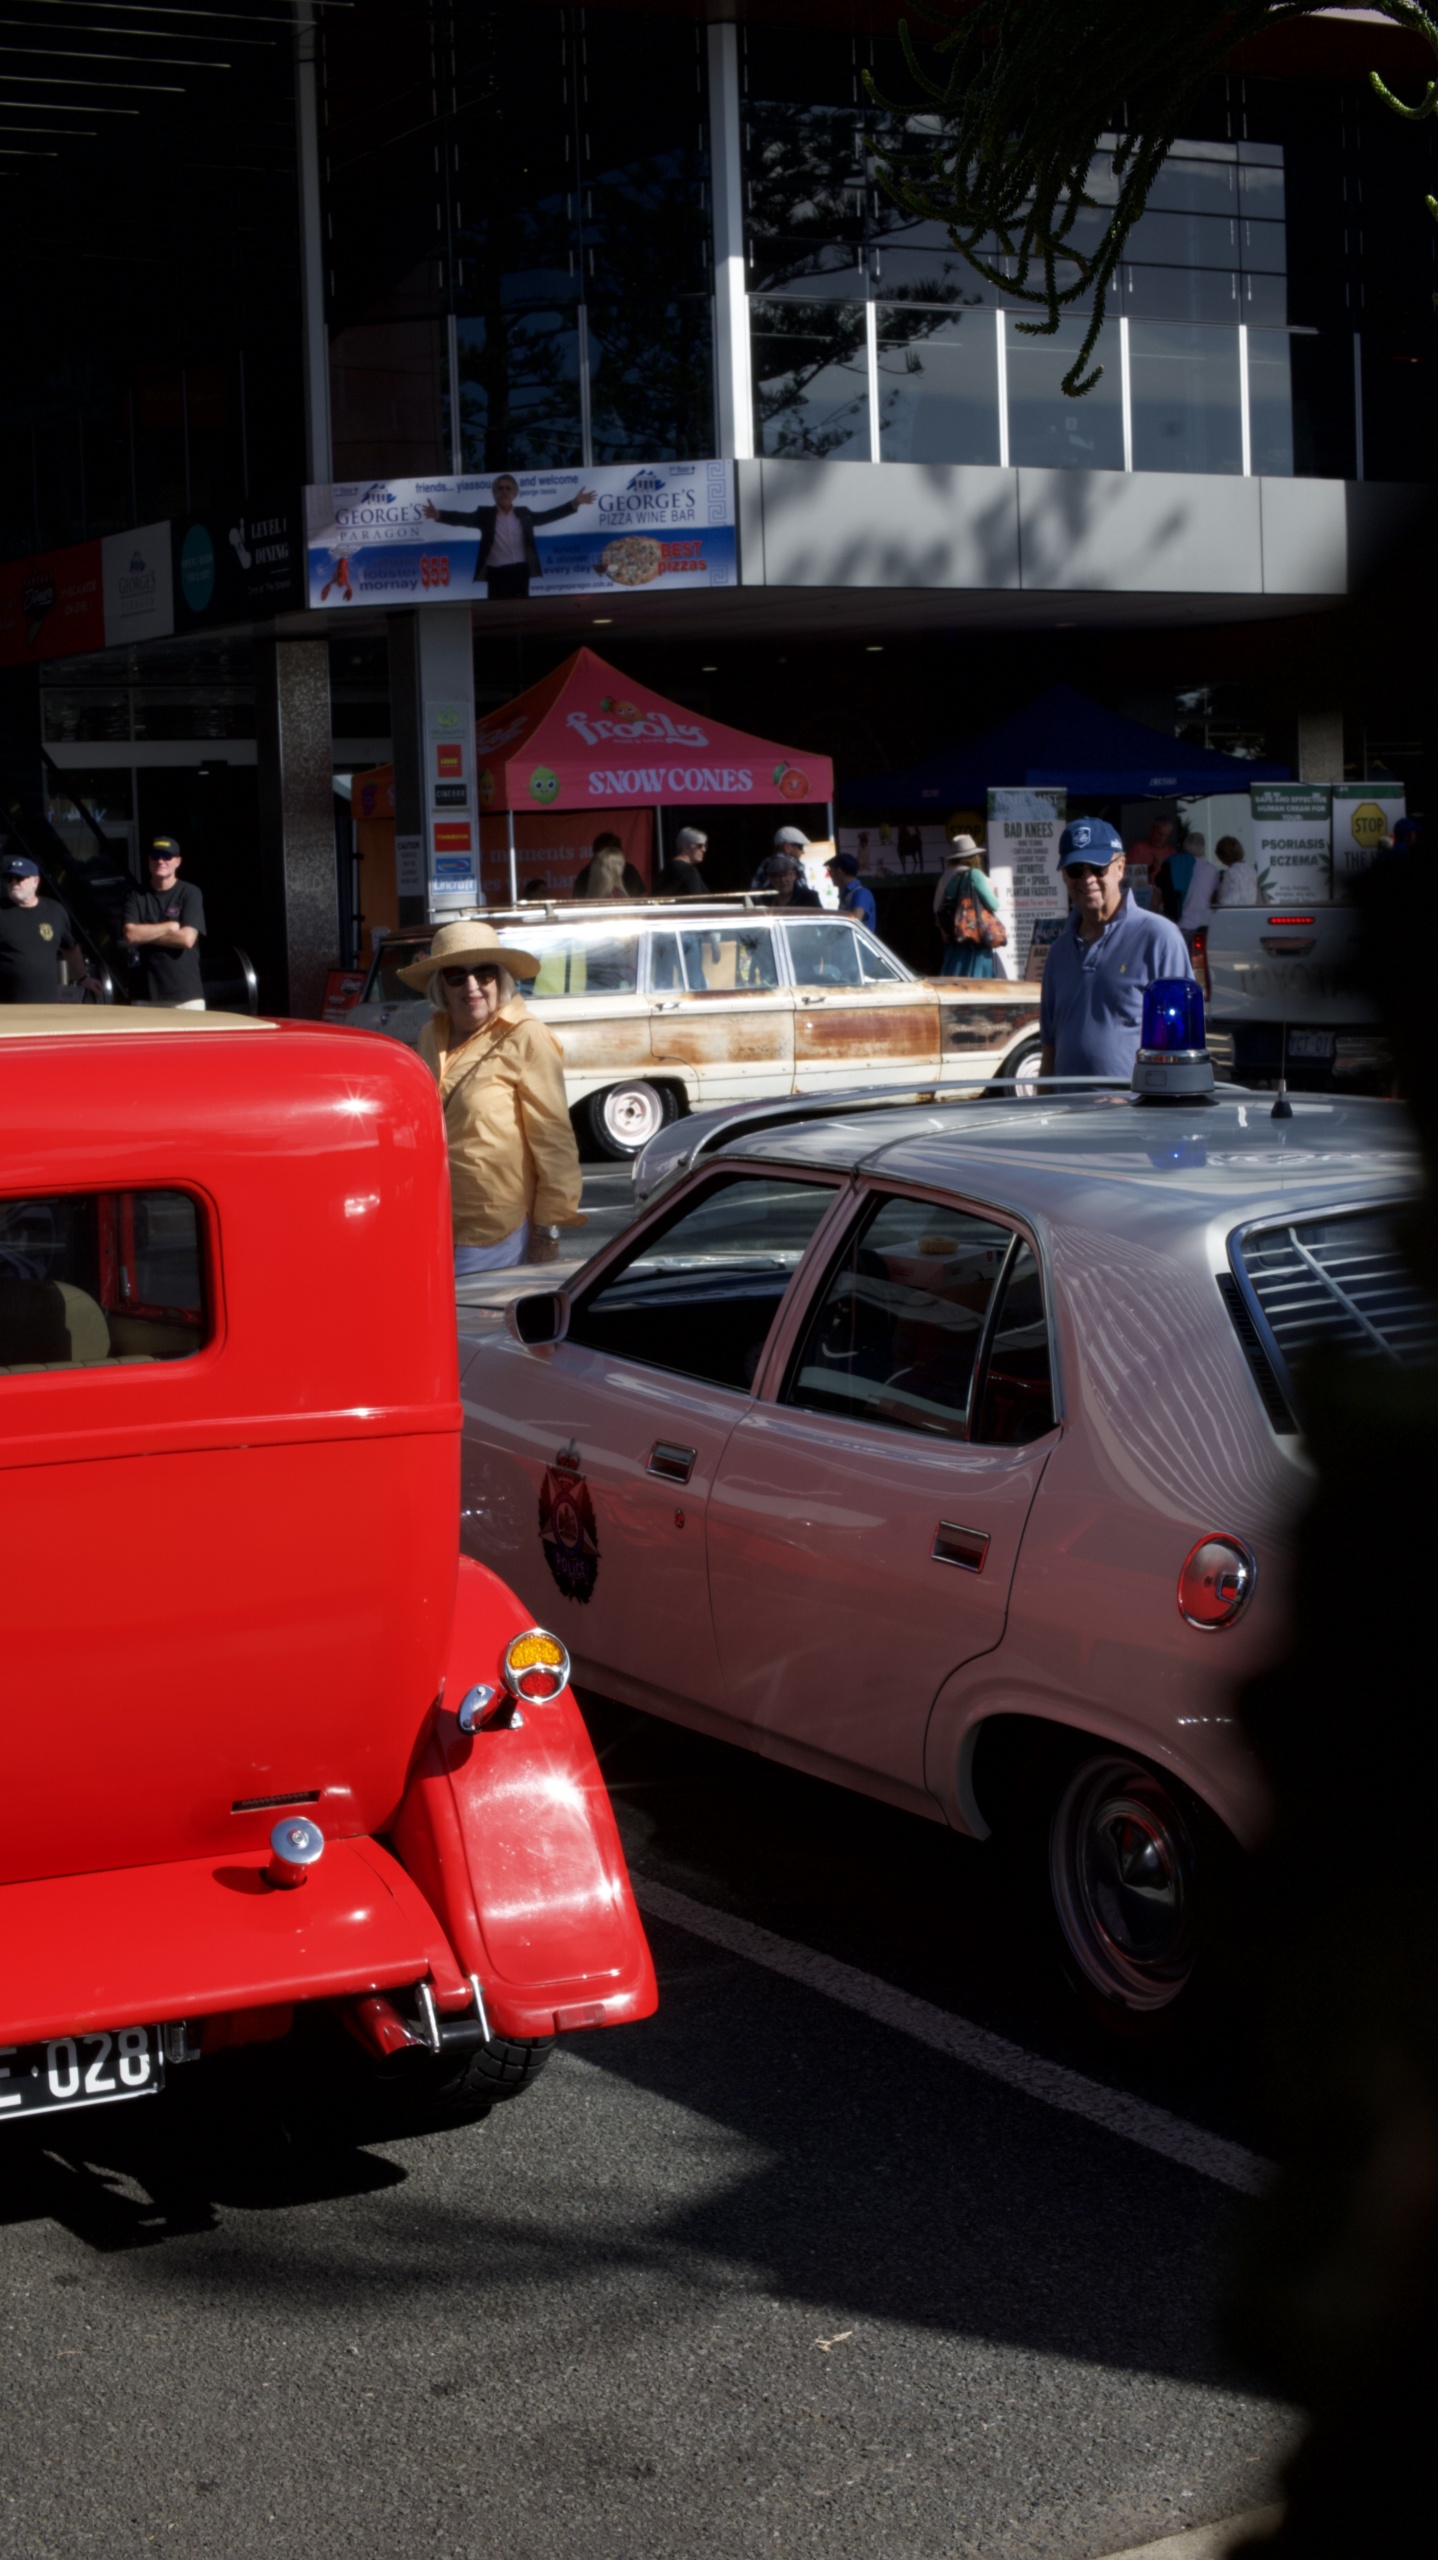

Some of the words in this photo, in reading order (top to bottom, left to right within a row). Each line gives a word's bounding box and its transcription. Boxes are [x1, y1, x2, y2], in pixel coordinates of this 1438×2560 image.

[456, 481, 491, 494] yiassou
[520, 475, 536, 487] and
[538, 473, 578, 486] welcome
[598, 490, 696, 512] GEORGE'S
[335, 503, 423, 526] GEORGE'S
[600, 511, 632, 526] PIZZA
[637, 510, 666, 524] WINE
[671, 509, 695, 522] BAR
[251, 517, 282, 540] LEVEL
[340, 526, 421, 542] PARAGON
[255, 542, 289, 564] DINING
[661, 540, 703, 557] BEST
[364, 567, 417, 579] lobster
[419, 553, 450, 591] $55
[543, 566, 570, 575] every
[573, 564, 591, 574] day
[658, 559, 707, 576] pizzas
[359, 580, 418, 591] mornay
[566, 711, 710, 748] frooly
[588, 768, 666, 795] SNOW
[668, 768, 753, 791] CONES
[1004, 822, 1022, 839] BAD
[1024, 822, 1054, 838] KNEES
[1355, 817, 1384, 833] STOP
[1261, 839, 1325, 850] PSORIASIS
[1269, 855, 1318, 867] ECZEMA
[1344, 851, 1366, 868] THE
[1016, 864, 1044, 874] ARTHRITIS
[433, 876, 475, 891] Lincraft
[1031, 875, 1049, 885] SPURS
[1006, 886, 1030, 897] PLANTAR
[555, 1552, 586, 1577] POLICE
[46, 2025, 152, 2099] 028
